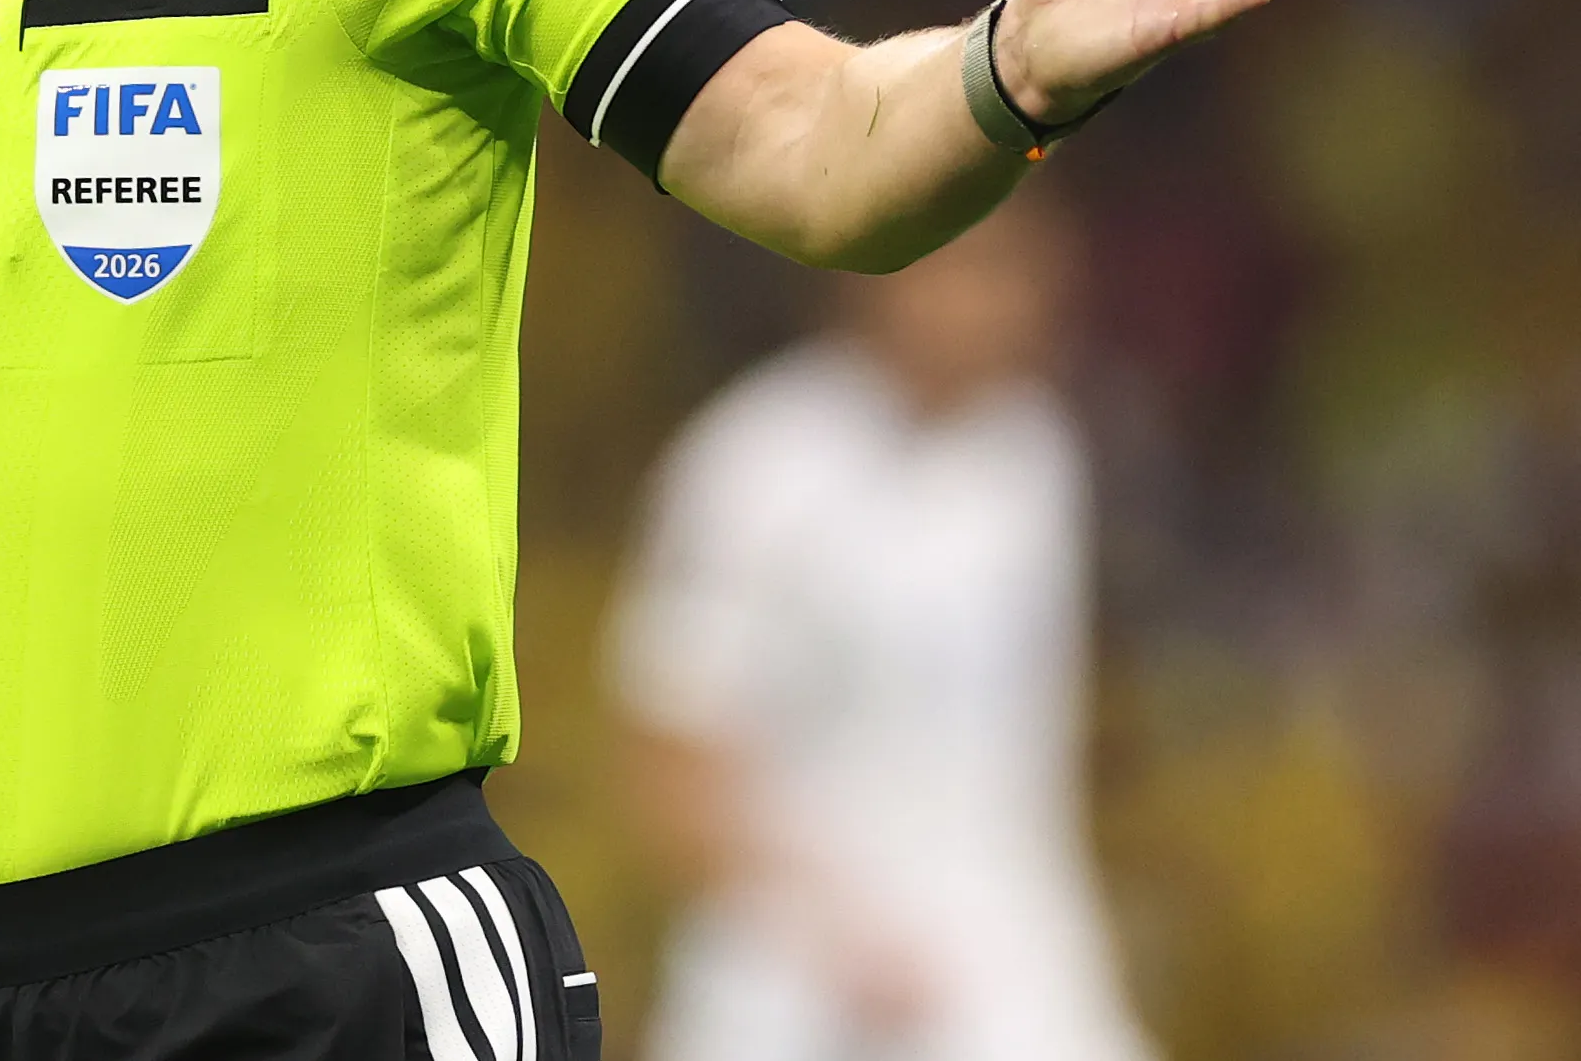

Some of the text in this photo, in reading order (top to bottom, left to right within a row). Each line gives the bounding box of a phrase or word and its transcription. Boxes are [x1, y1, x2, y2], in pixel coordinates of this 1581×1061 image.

[54, 83, 202, 136] FIFA
[52, 176, 201, 204] REFEREE
[93, 253, 160, 278] 2026
